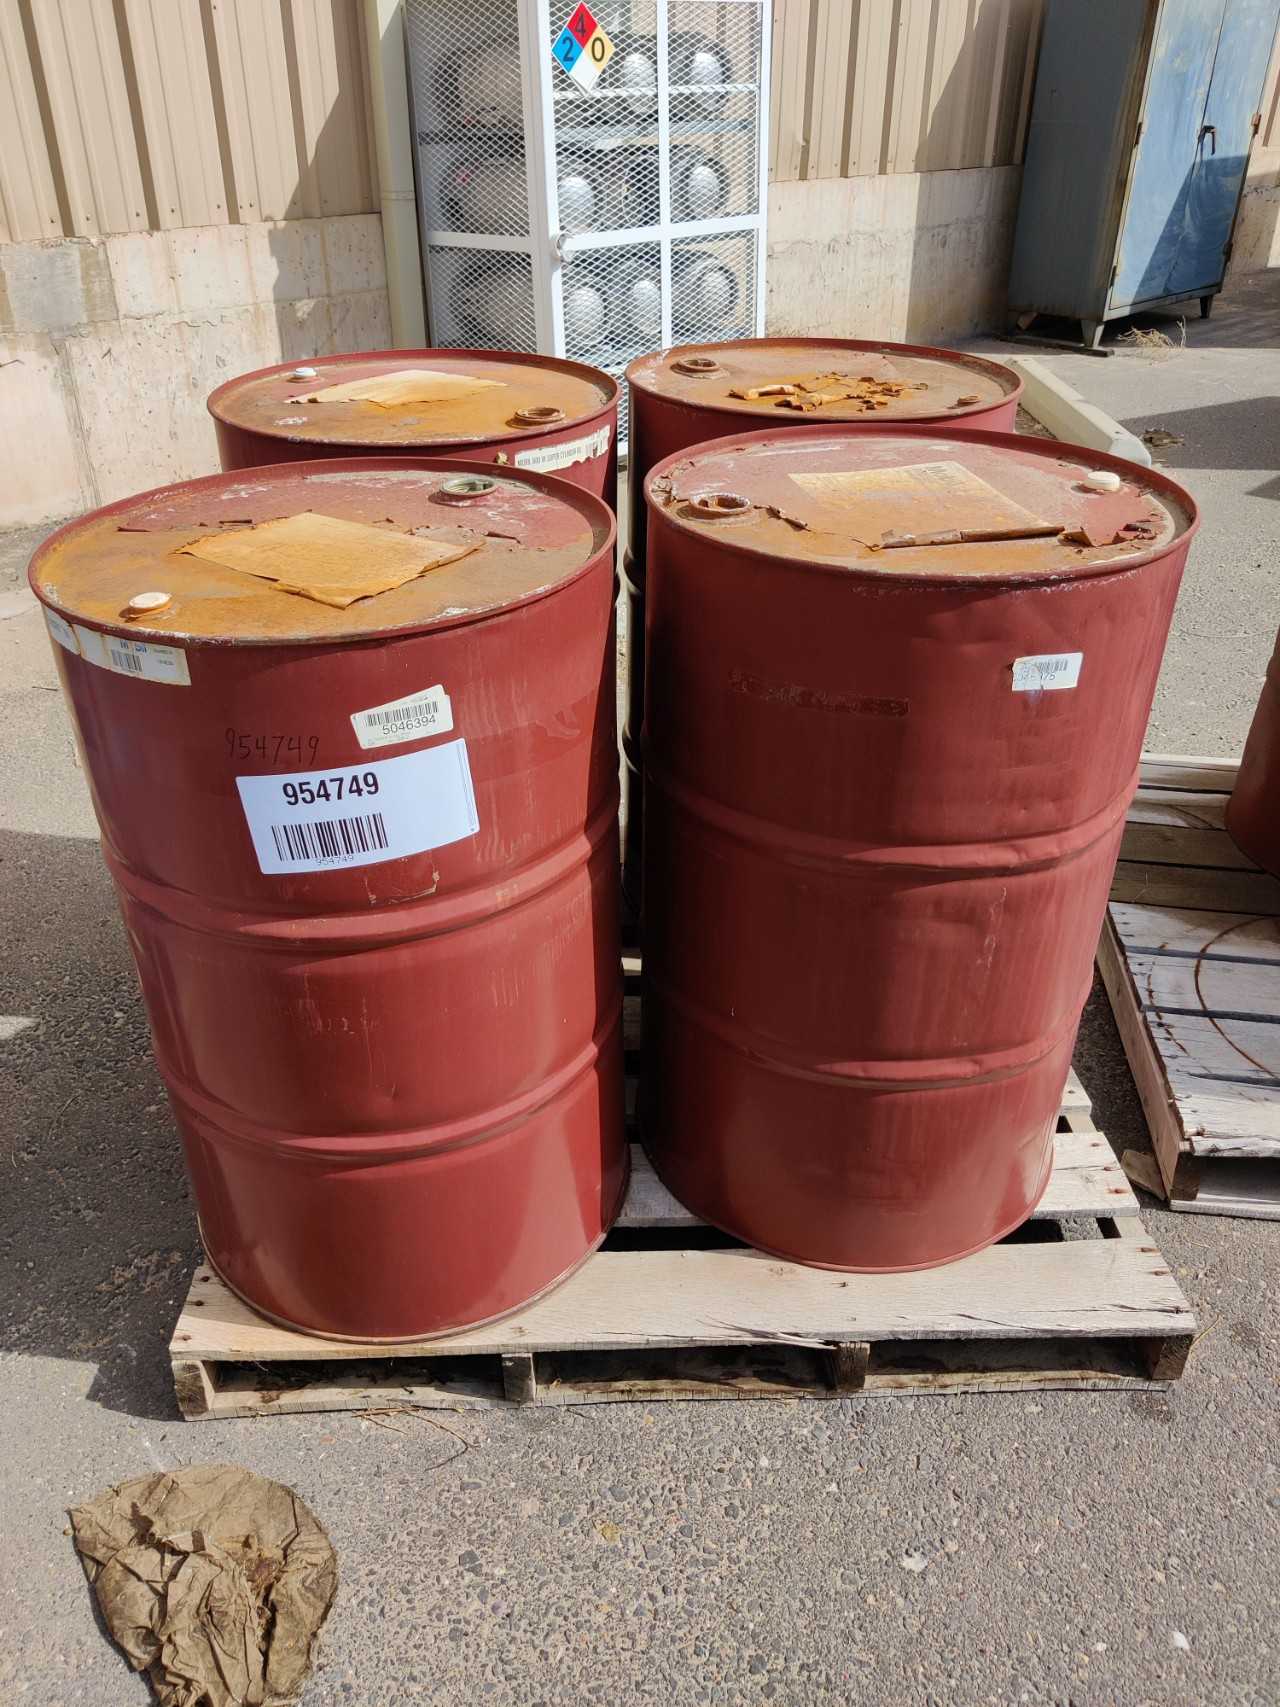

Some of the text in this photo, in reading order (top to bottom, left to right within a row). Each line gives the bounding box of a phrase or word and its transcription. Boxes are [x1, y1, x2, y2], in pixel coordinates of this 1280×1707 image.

[575, 13, 587, 38] 4
[562, 36, 575, 62] 2
[591, 36, 605, 63] 0
[382, 714, 437, 736] 5046394
[224, 727, 320, 766] 954749
[282, 771, 379, 806] 954749
